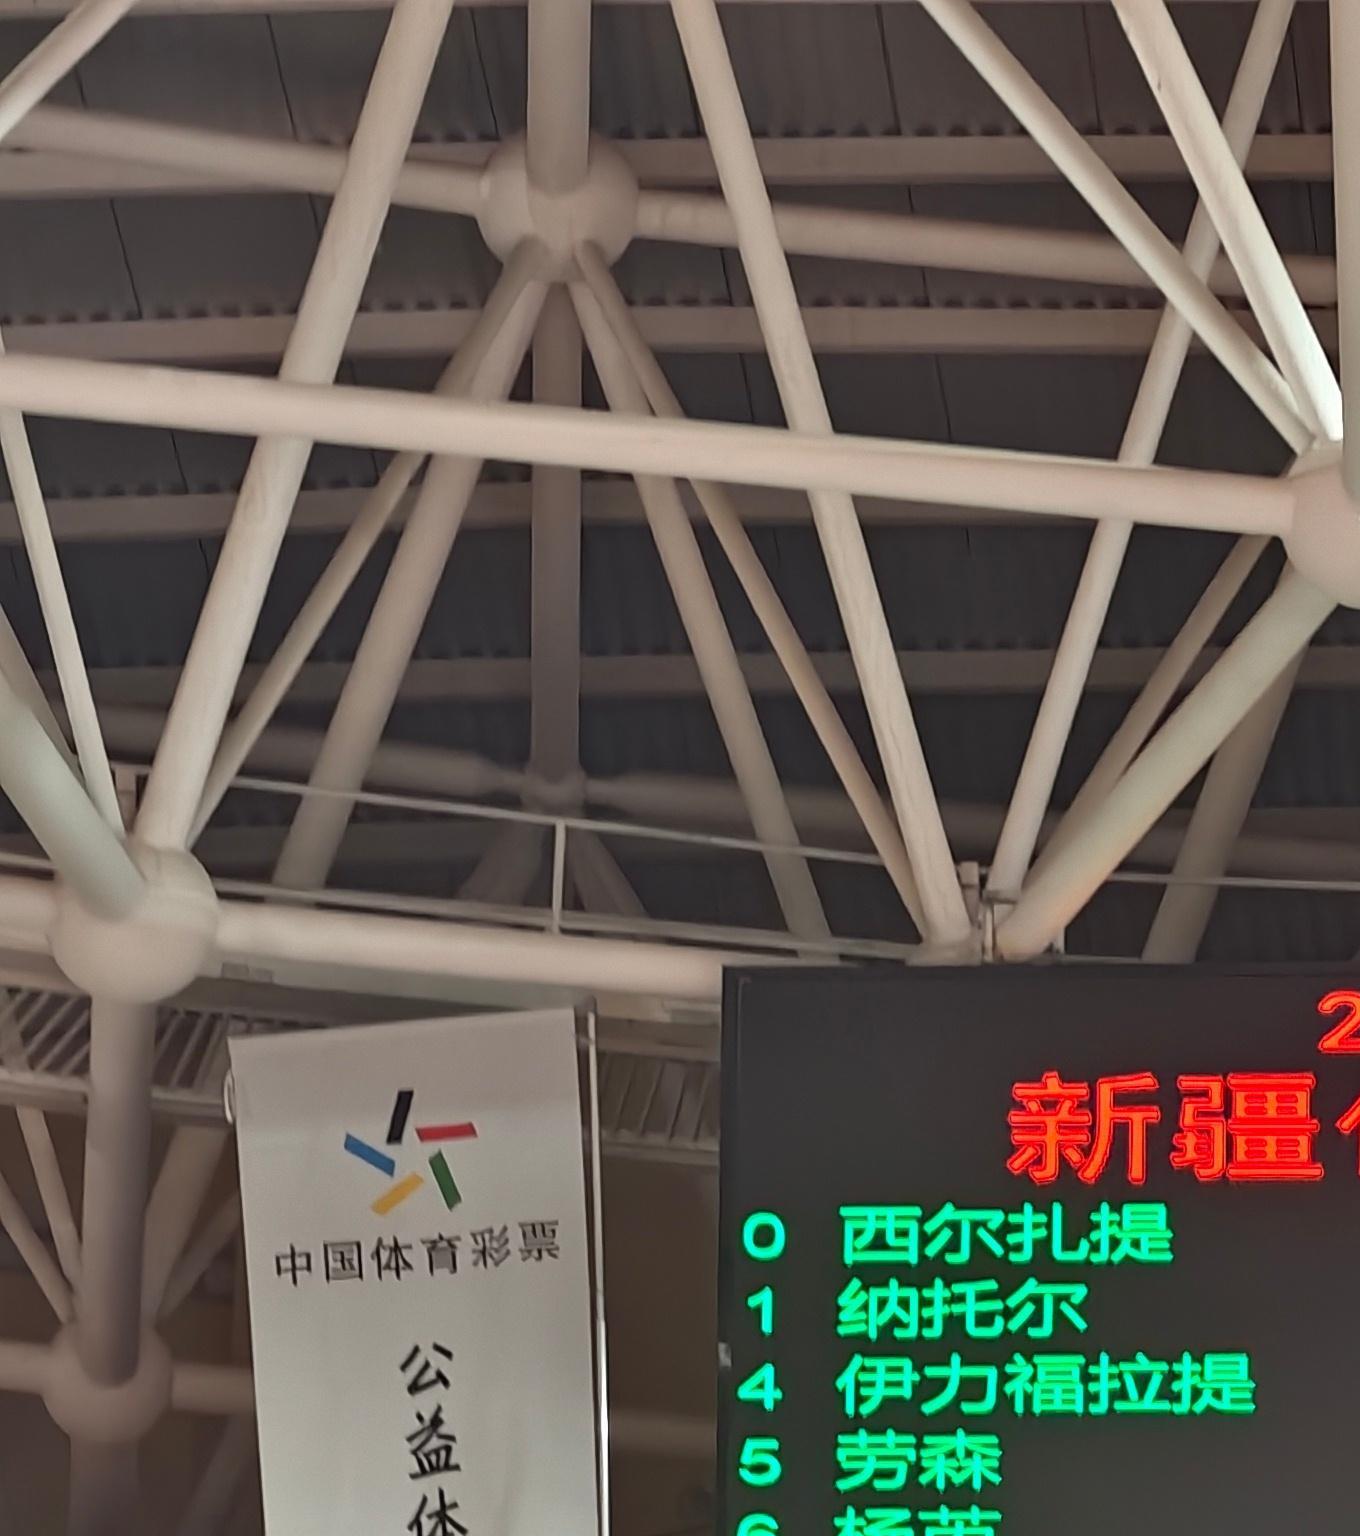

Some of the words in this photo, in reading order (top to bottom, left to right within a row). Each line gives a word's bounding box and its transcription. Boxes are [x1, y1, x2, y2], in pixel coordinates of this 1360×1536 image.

[276, 1220, 560, 1286] 中国体育彩票
[741, 1211, 788, 1263] 0
[838, 1201, 1174, 1269] 西尔扎提
[746, 1286, 775, 1336] 1
[835, 1275, 1089, 1343] 纳托尔
[736, 1361, 784, 1412] 4
[833, 1350, 1257, 1419] 伊力福拉提
[737, 1436, 783, 1488] 5
[834, 1426, 1003, 1493] 劳森
